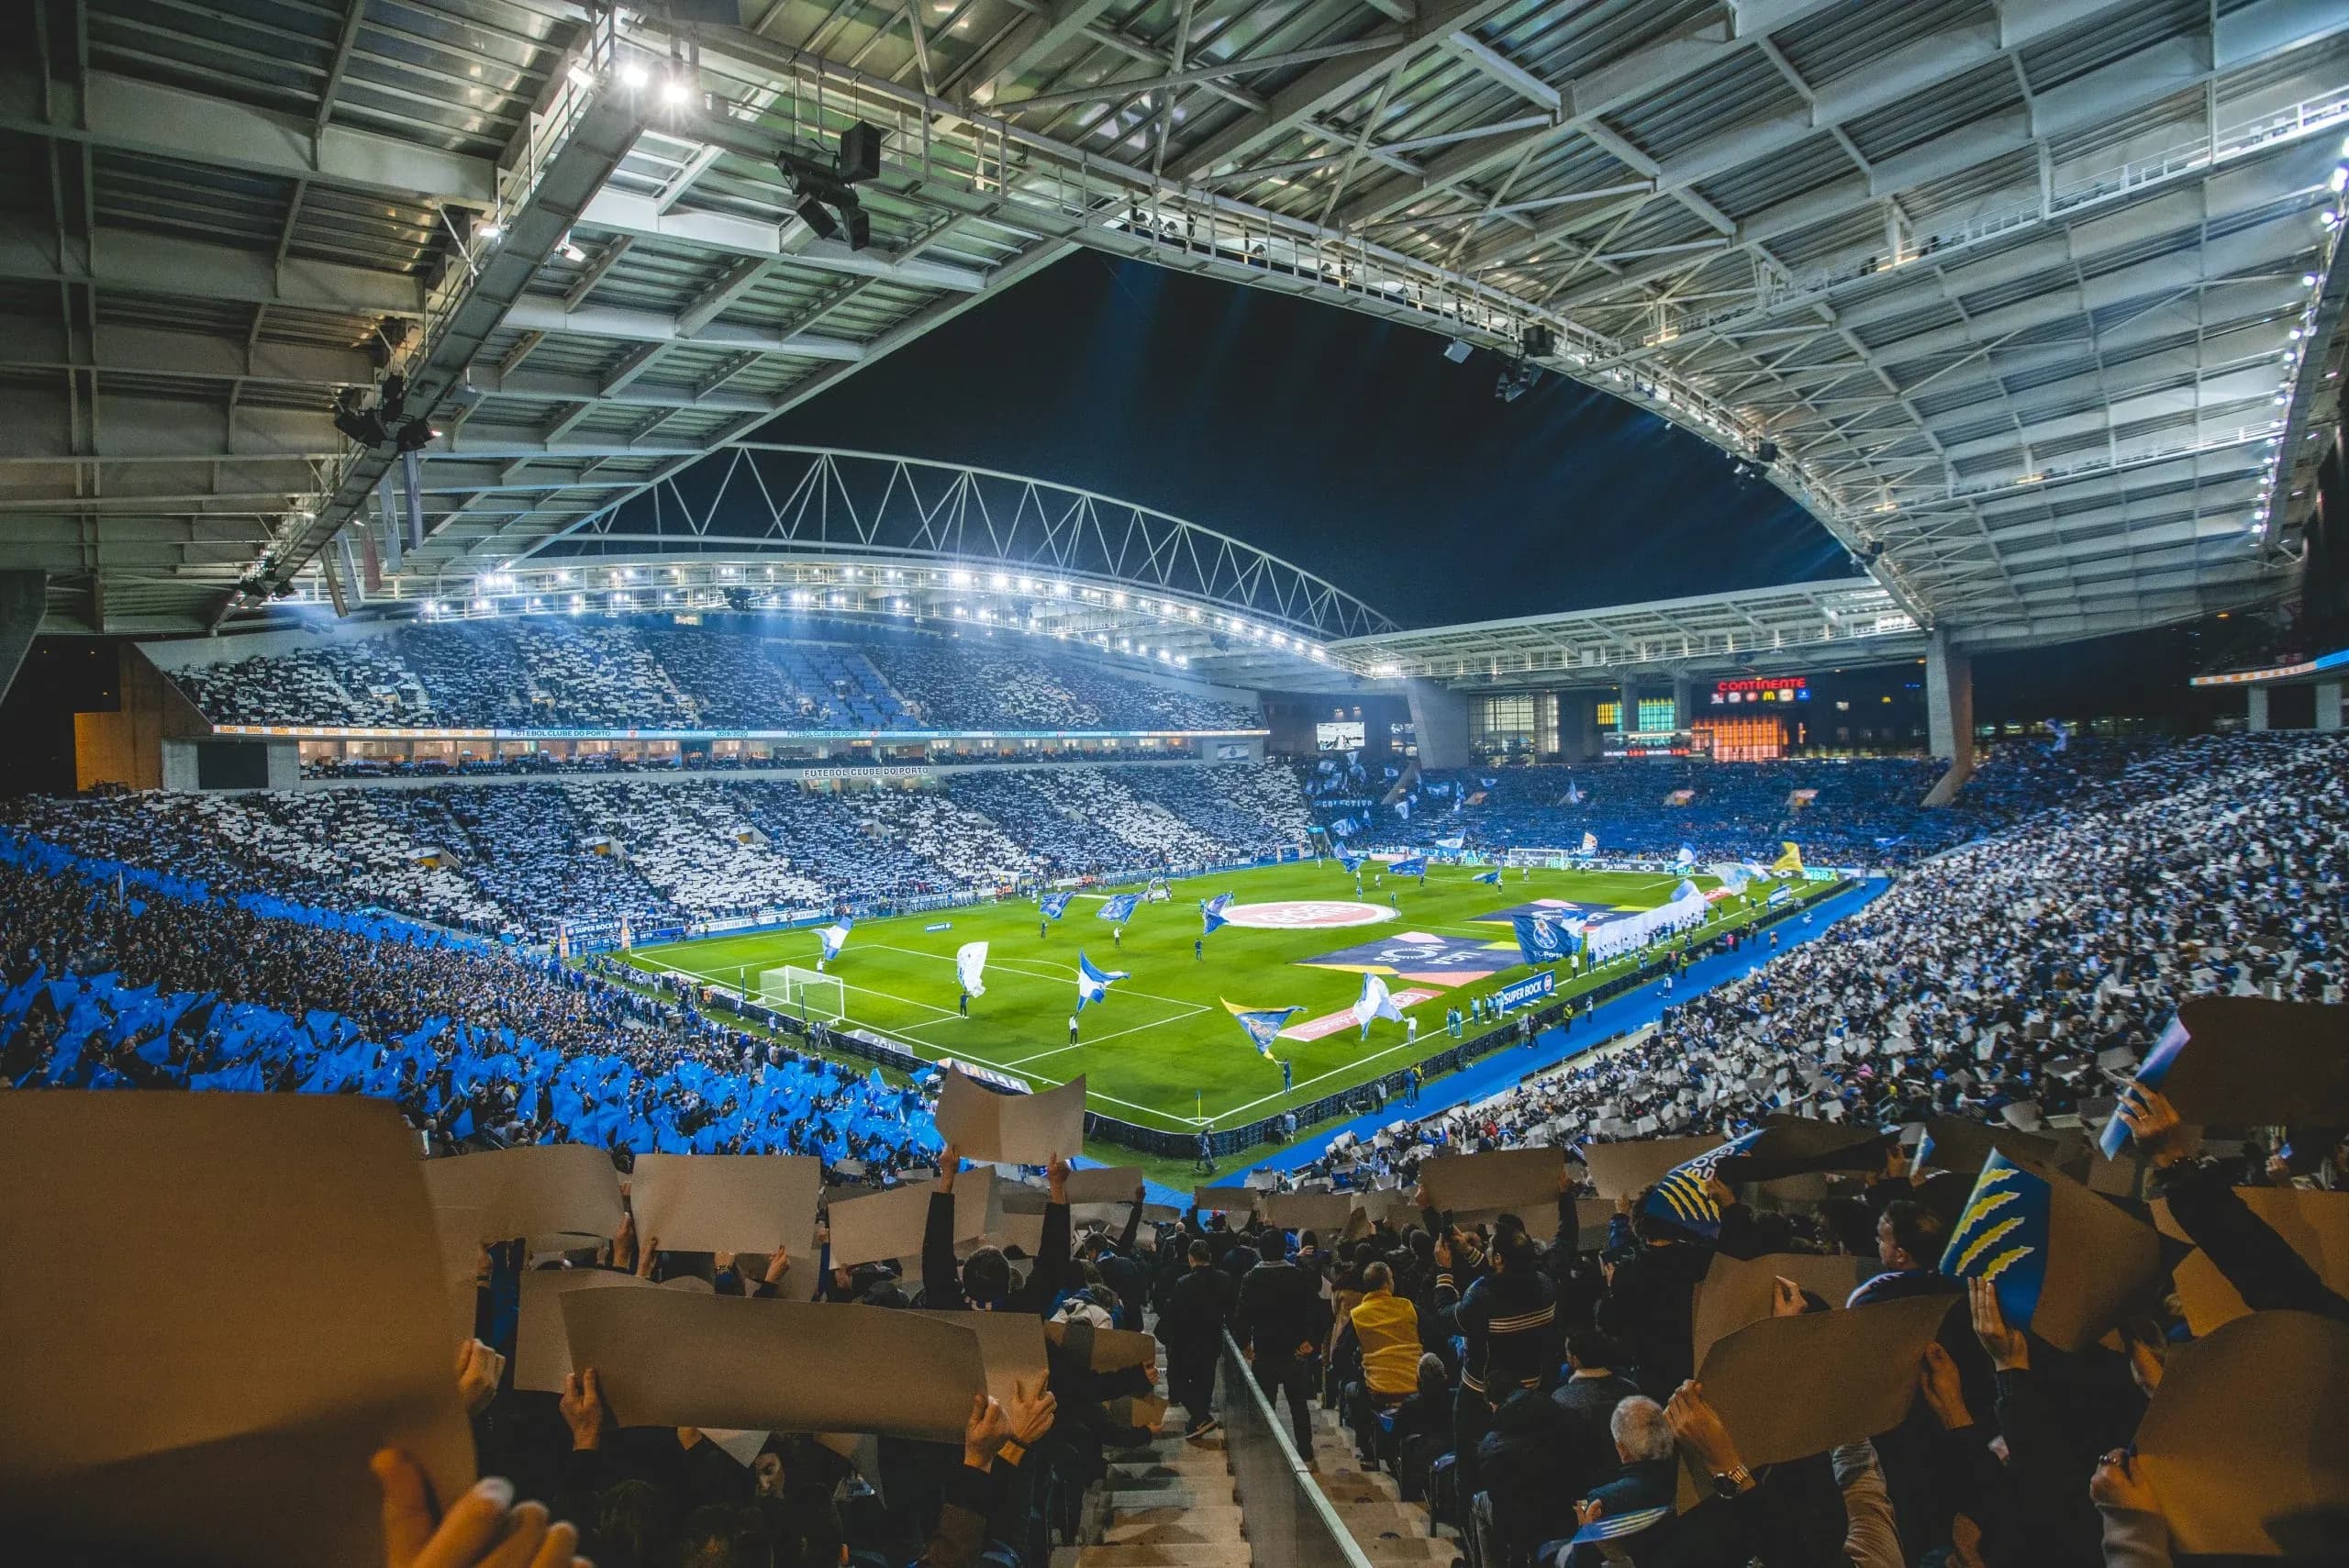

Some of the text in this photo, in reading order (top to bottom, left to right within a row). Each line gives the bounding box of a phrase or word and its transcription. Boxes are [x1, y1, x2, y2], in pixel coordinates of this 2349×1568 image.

[804, 769, 847, 777] FUTEBOL
[850, 768, 881, 776] CLUBE
[884, 767, 896, 775] DO
[1462, 855, 1486, 865] FIBRA
[575, 923, 613, 934] SUPER BOCK
[1504, 981, 1542, 1006] SUPER BOCK
